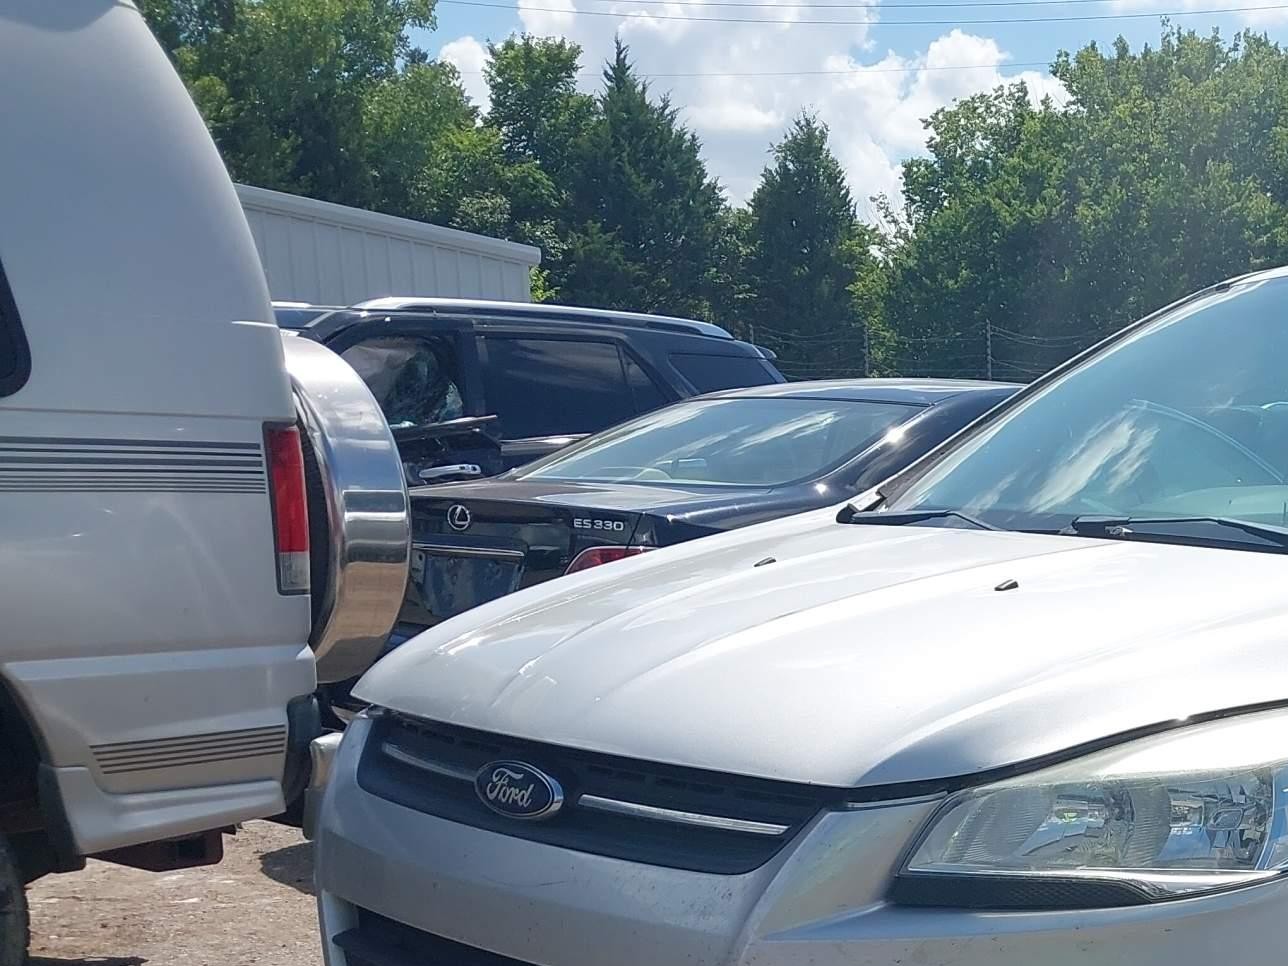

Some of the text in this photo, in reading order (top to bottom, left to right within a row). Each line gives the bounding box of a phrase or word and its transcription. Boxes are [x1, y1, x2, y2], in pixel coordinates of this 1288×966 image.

[573, 518, 625, 531] ES 330
[486, 767, 535, 808] Ford
